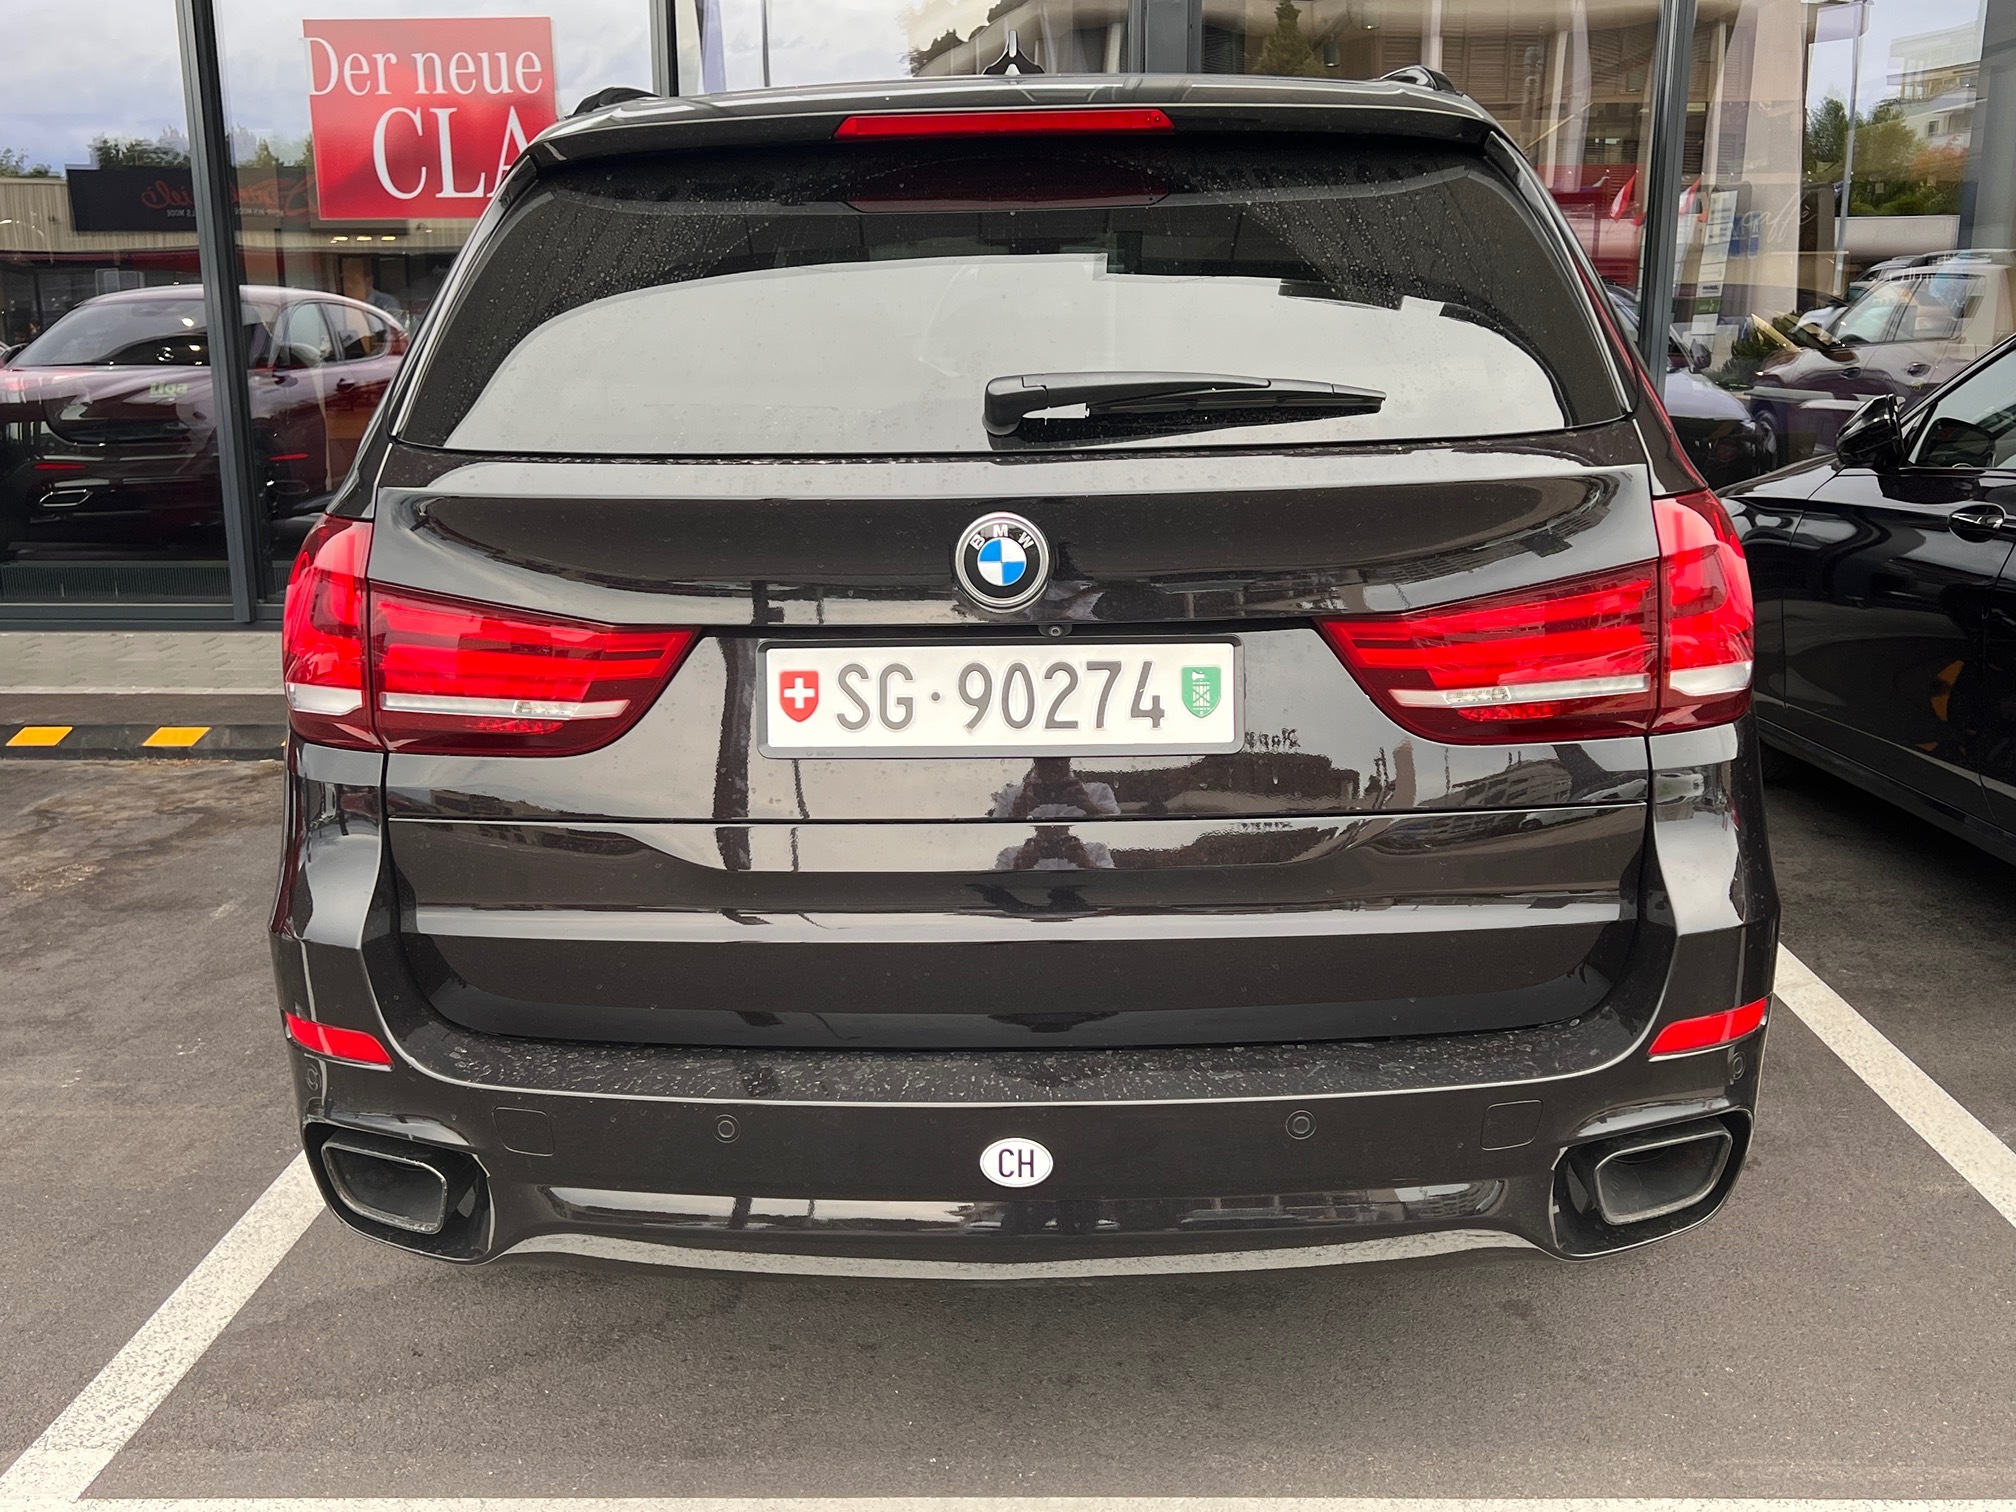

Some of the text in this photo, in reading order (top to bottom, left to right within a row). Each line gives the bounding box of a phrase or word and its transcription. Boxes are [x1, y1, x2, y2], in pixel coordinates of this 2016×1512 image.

[299, 37, 543, 96] Der neue
[969, 524, 1034, 550] BMW
[836, 662, 915, 731] SG
[957, 660, 1165, 732] 90274
[998, 1148, 1035, 1178] CH
